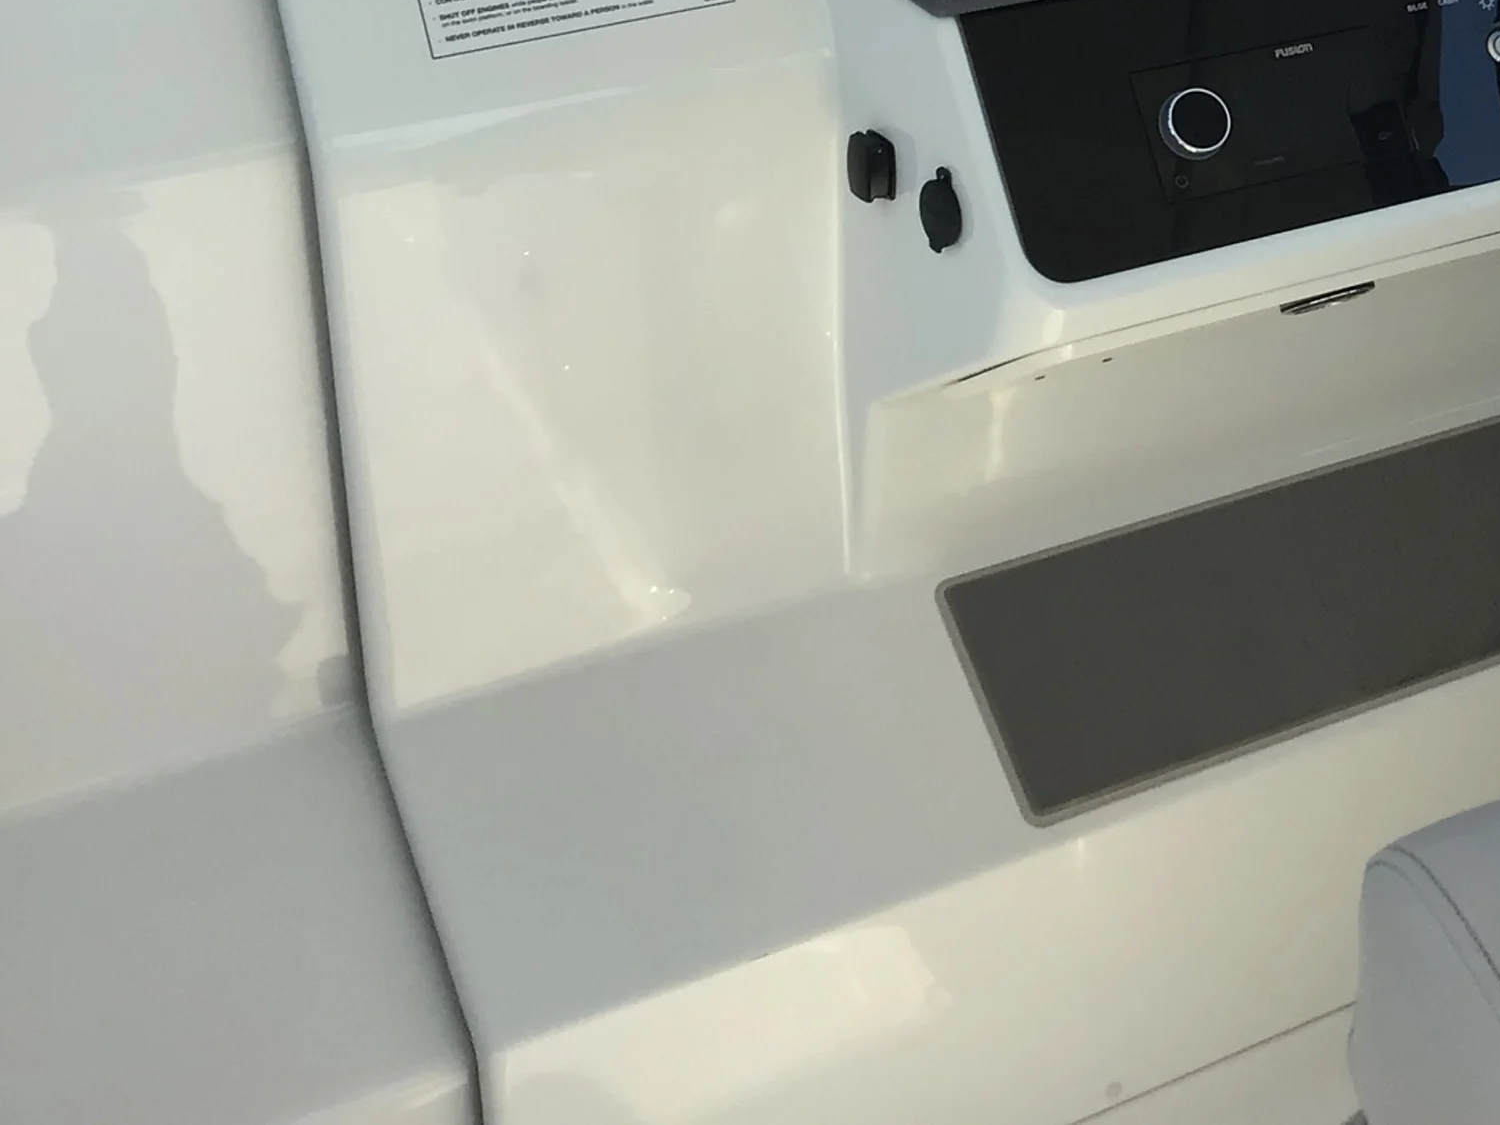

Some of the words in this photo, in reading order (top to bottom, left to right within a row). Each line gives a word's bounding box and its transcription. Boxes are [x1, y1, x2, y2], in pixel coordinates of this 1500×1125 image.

[439, 11, 460, 21] SHUT
[460, 8, 476, 17] OFF
[476, 2, 510, 14] ENGINES
[445, 31, 471, 43] NEVER
[471, 25, 506, 38] OPERATE
[506, 23, 515, 31] IN
[515, 16, 550, 30] REVERSE
[550, 10, 583, 23] TOWARD
[583, 9, 589, 17] A
[589, 3, 620, 16] PERSON
[1274, 42, 1313, 59] FUSION
